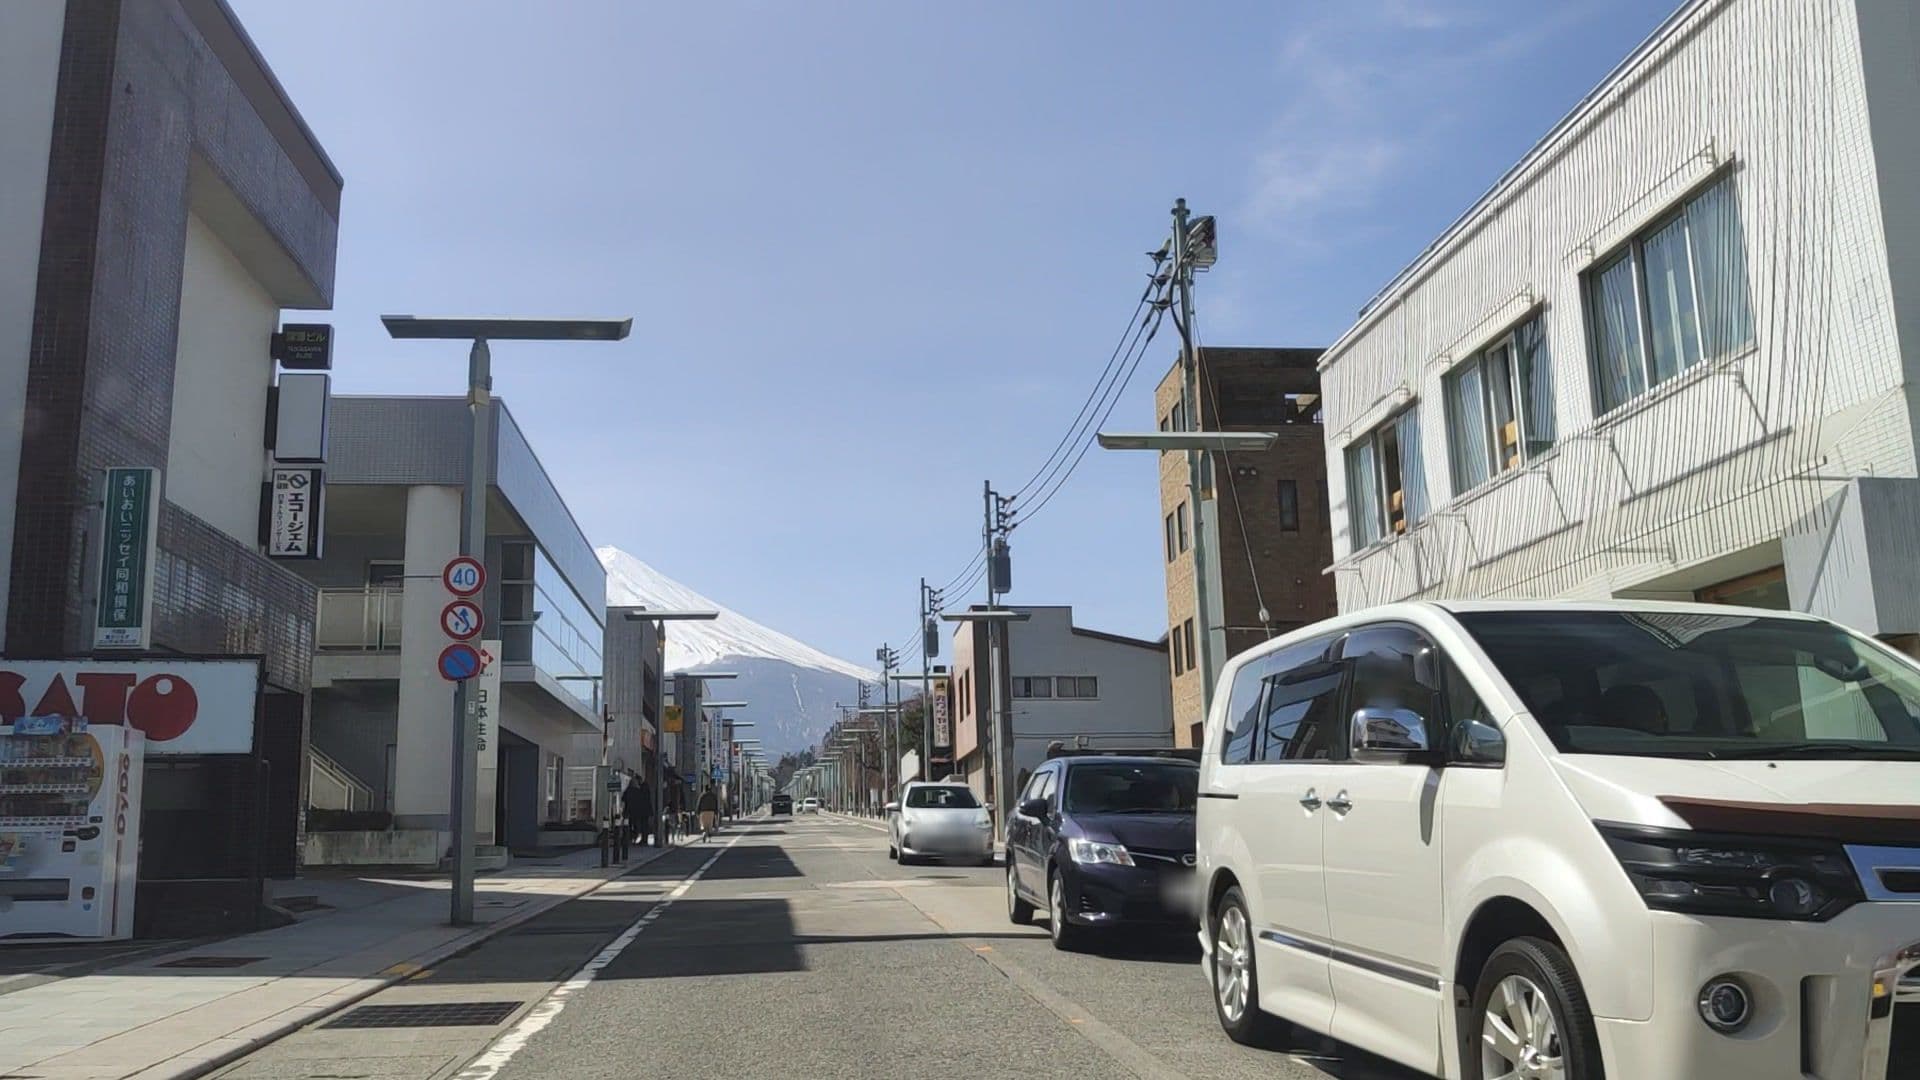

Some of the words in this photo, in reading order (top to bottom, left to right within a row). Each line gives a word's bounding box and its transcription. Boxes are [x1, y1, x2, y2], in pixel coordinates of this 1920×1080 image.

[287, 331, 327, 342] ビル
[285, 492, 304, 552] エコージェム
[113, 476, 136, 622] あいおいニッセイ同和損保
[453, 568, 476, 586] 40
